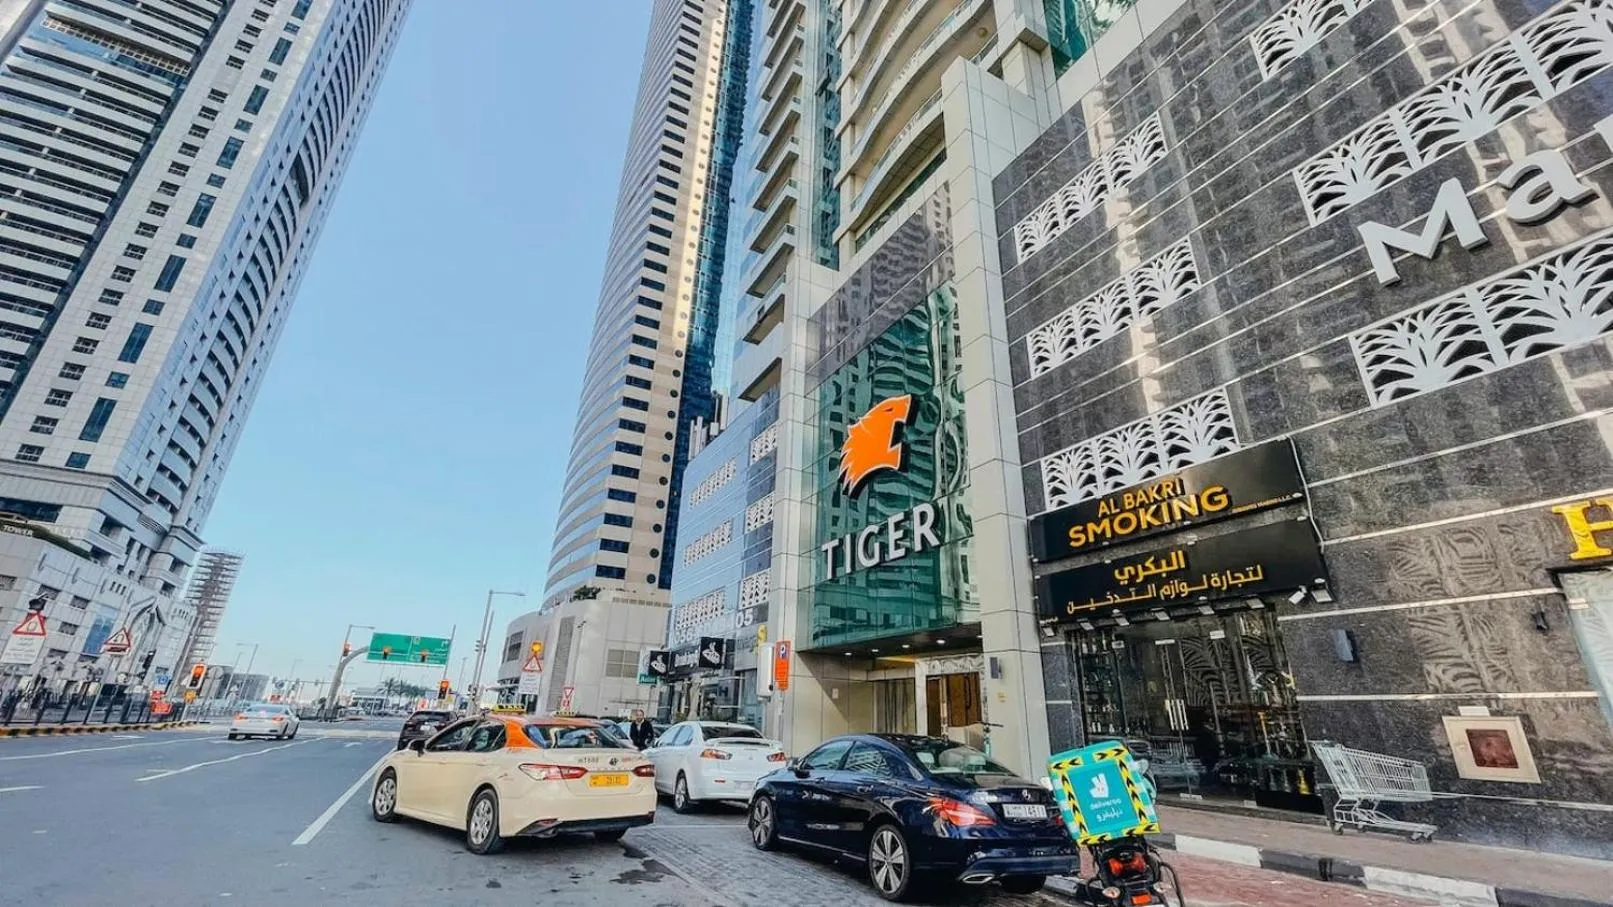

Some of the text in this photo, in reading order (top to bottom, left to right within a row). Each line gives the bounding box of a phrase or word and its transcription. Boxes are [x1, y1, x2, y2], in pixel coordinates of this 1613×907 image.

[1356, 113, 1613, 286] Ma
[1068, 484, 1229, 548] SMOKING
[1098, 478, 1182, 518] AL BAKRI
[821, 502, 940, 580] TIGER
[1114, 550, 1186, 585] البكري
[1210, 564, 1264, 590] لتجارة
